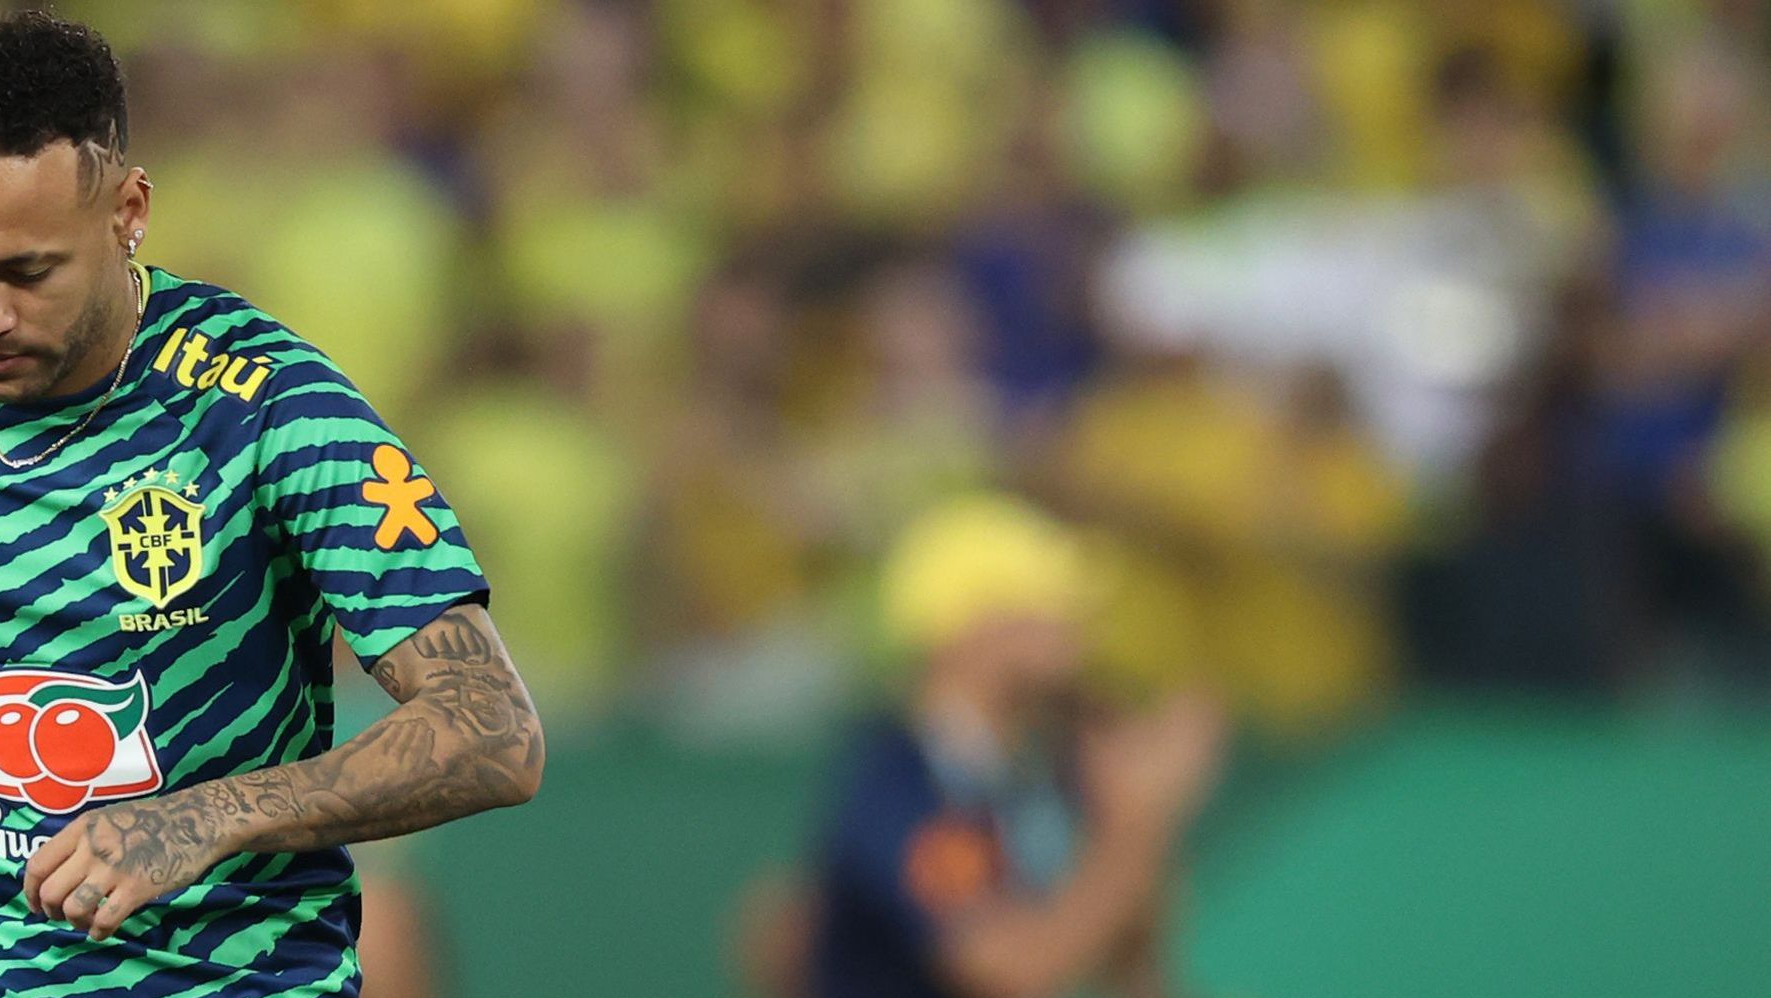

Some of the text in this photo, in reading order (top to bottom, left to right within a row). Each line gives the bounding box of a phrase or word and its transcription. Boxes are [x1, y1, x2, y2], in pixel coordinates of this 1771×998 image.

[152, 327, 275, 403] Itaú
[139, 533, 173, 549] CBF
[118, 607, 210, 632] BRASIL
